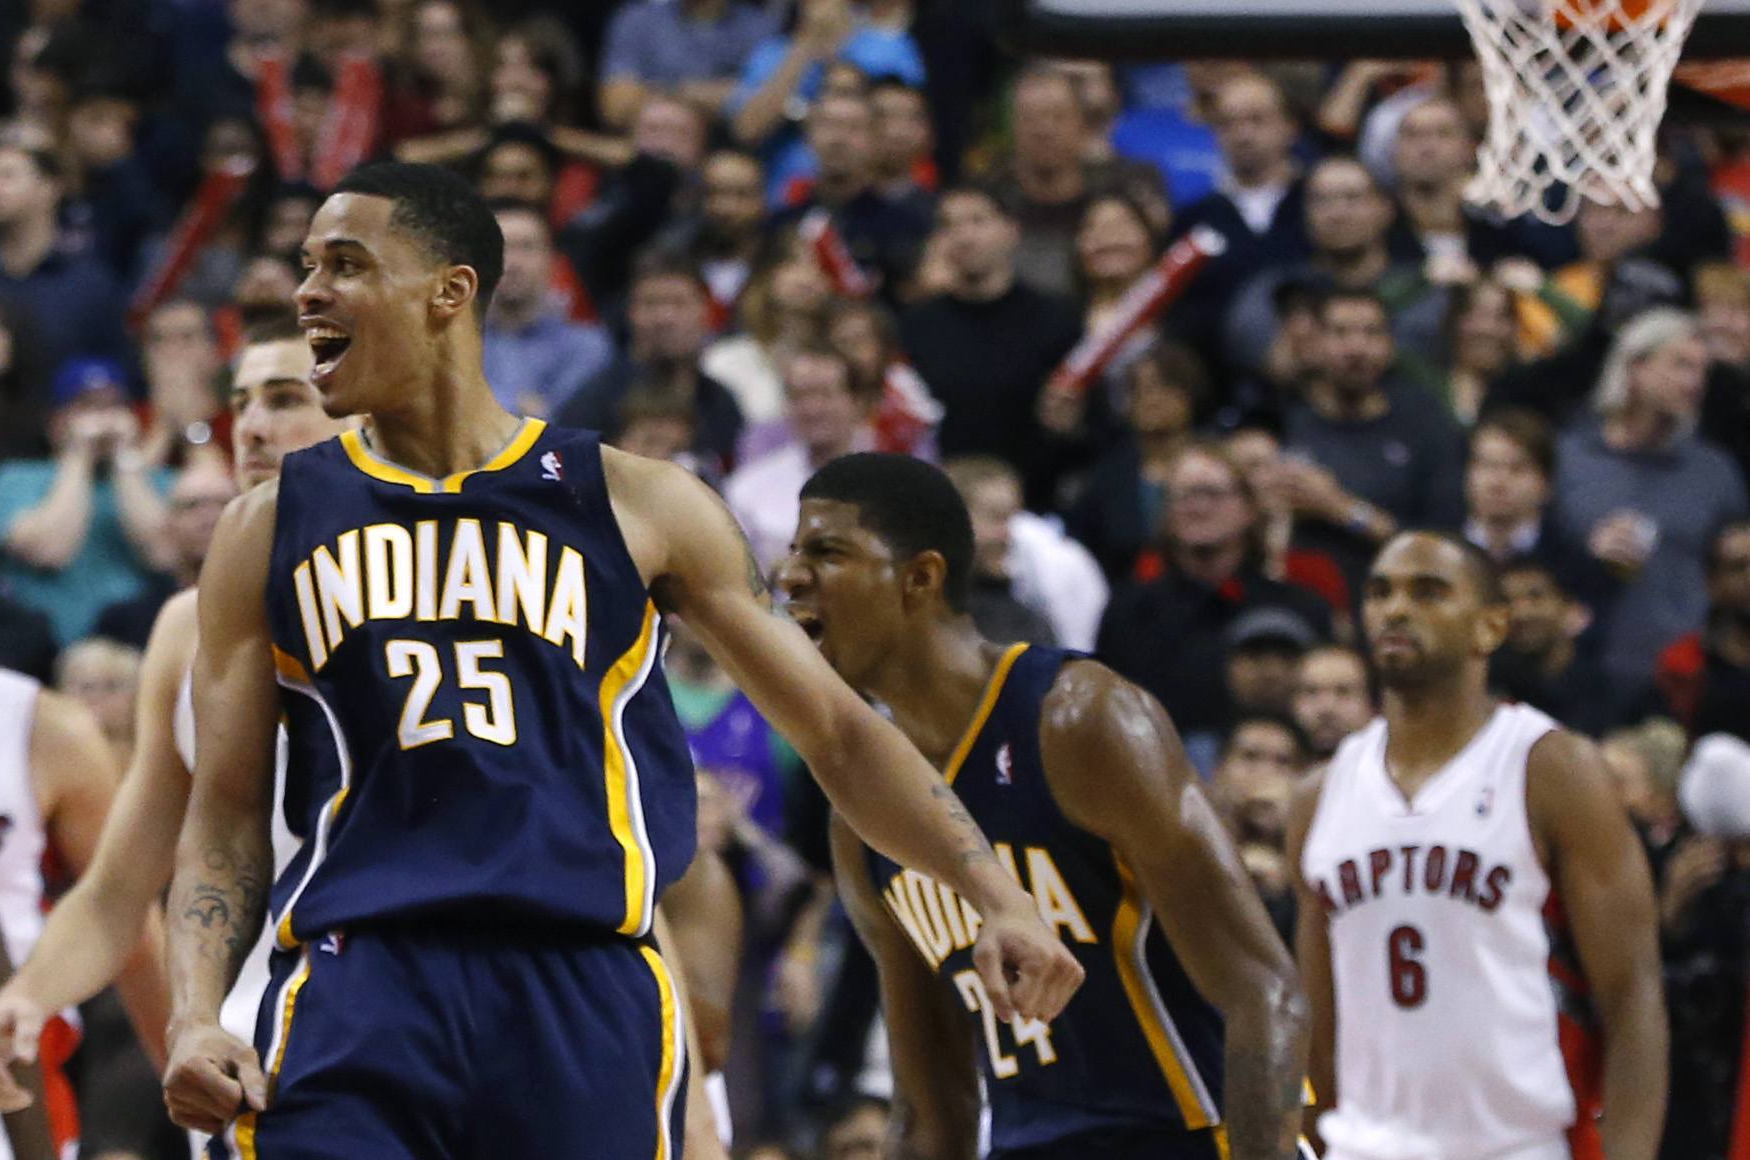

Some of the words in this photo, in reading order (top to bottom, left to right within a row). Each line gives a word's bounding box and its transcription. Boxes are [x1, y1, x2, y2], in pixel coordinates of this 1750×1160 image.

[293, 518, 587, 673] INDIANA
[384, 638, 517, 750] 25
[883, 843, 1098, 973] NDIA
[1387, 922, 1427, 1009] 6
[954, 970, 1058, 1079] 24
